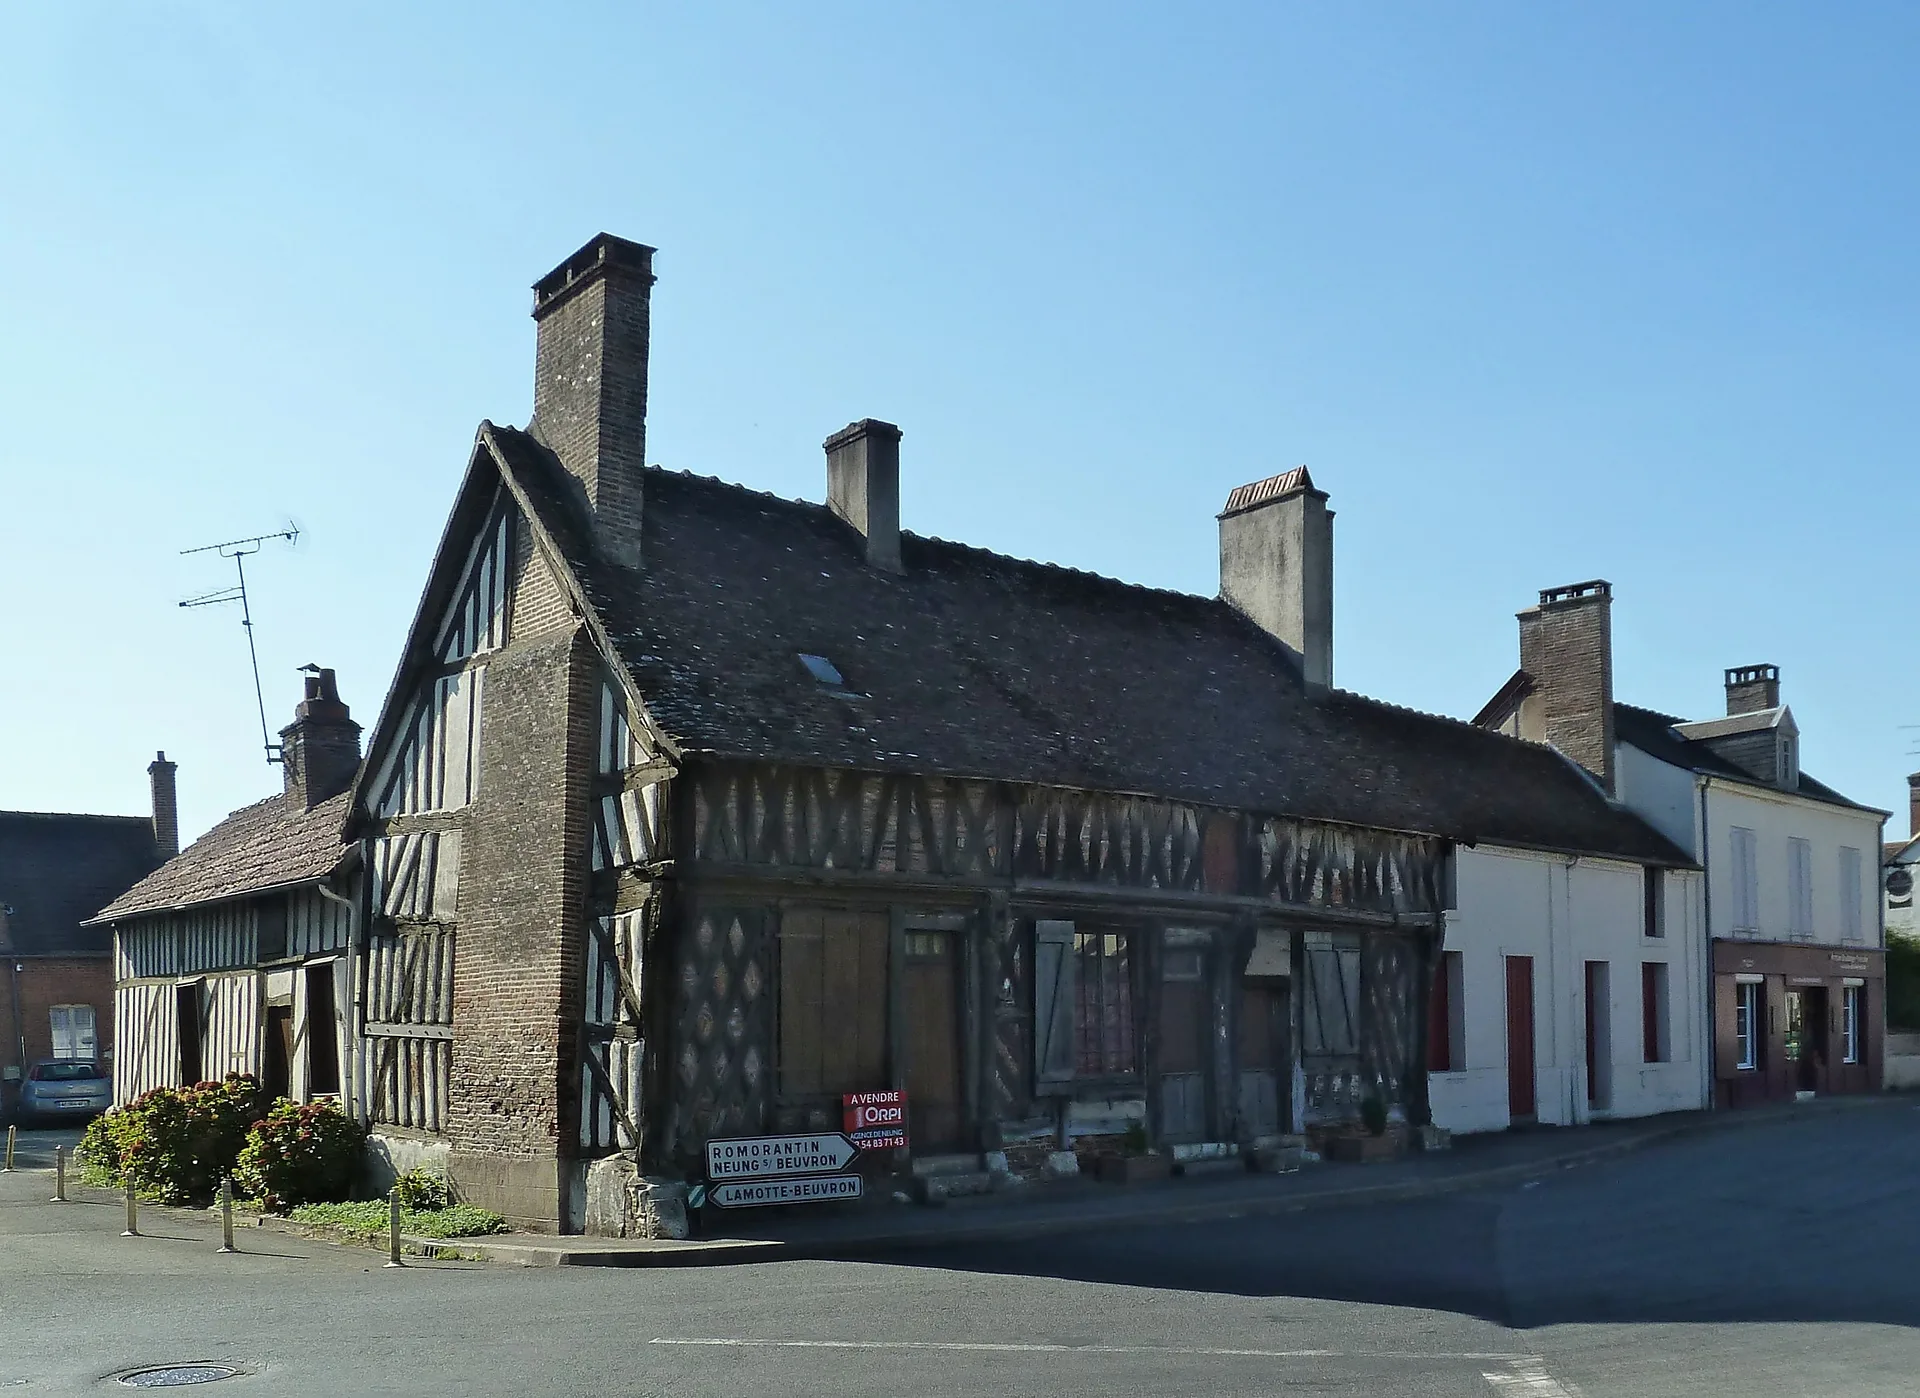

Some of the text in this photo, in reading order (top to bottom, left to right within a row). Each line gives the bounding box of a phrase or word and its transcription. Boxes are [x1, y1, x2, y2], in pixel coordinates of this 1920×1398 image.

[851, 1092, 899, 1104] A VENDRE
[850, 1131, 873, 1140] AGENCE
[861, 1140, 872, 1149] 54
[873, 1139, 883, 1148] 83
[884, 1138, 893, 1147] 71
[894, 1137, 904, 1146] 43
[713, 1141, 820, 1159] ROMORANTIN
[714, 1158, 760, 1174] NEUNG
[776, 1154, 837, 1170] BEUVRON
[725, 1181, 857, 1201] LAMOTTE-BEUVRON
